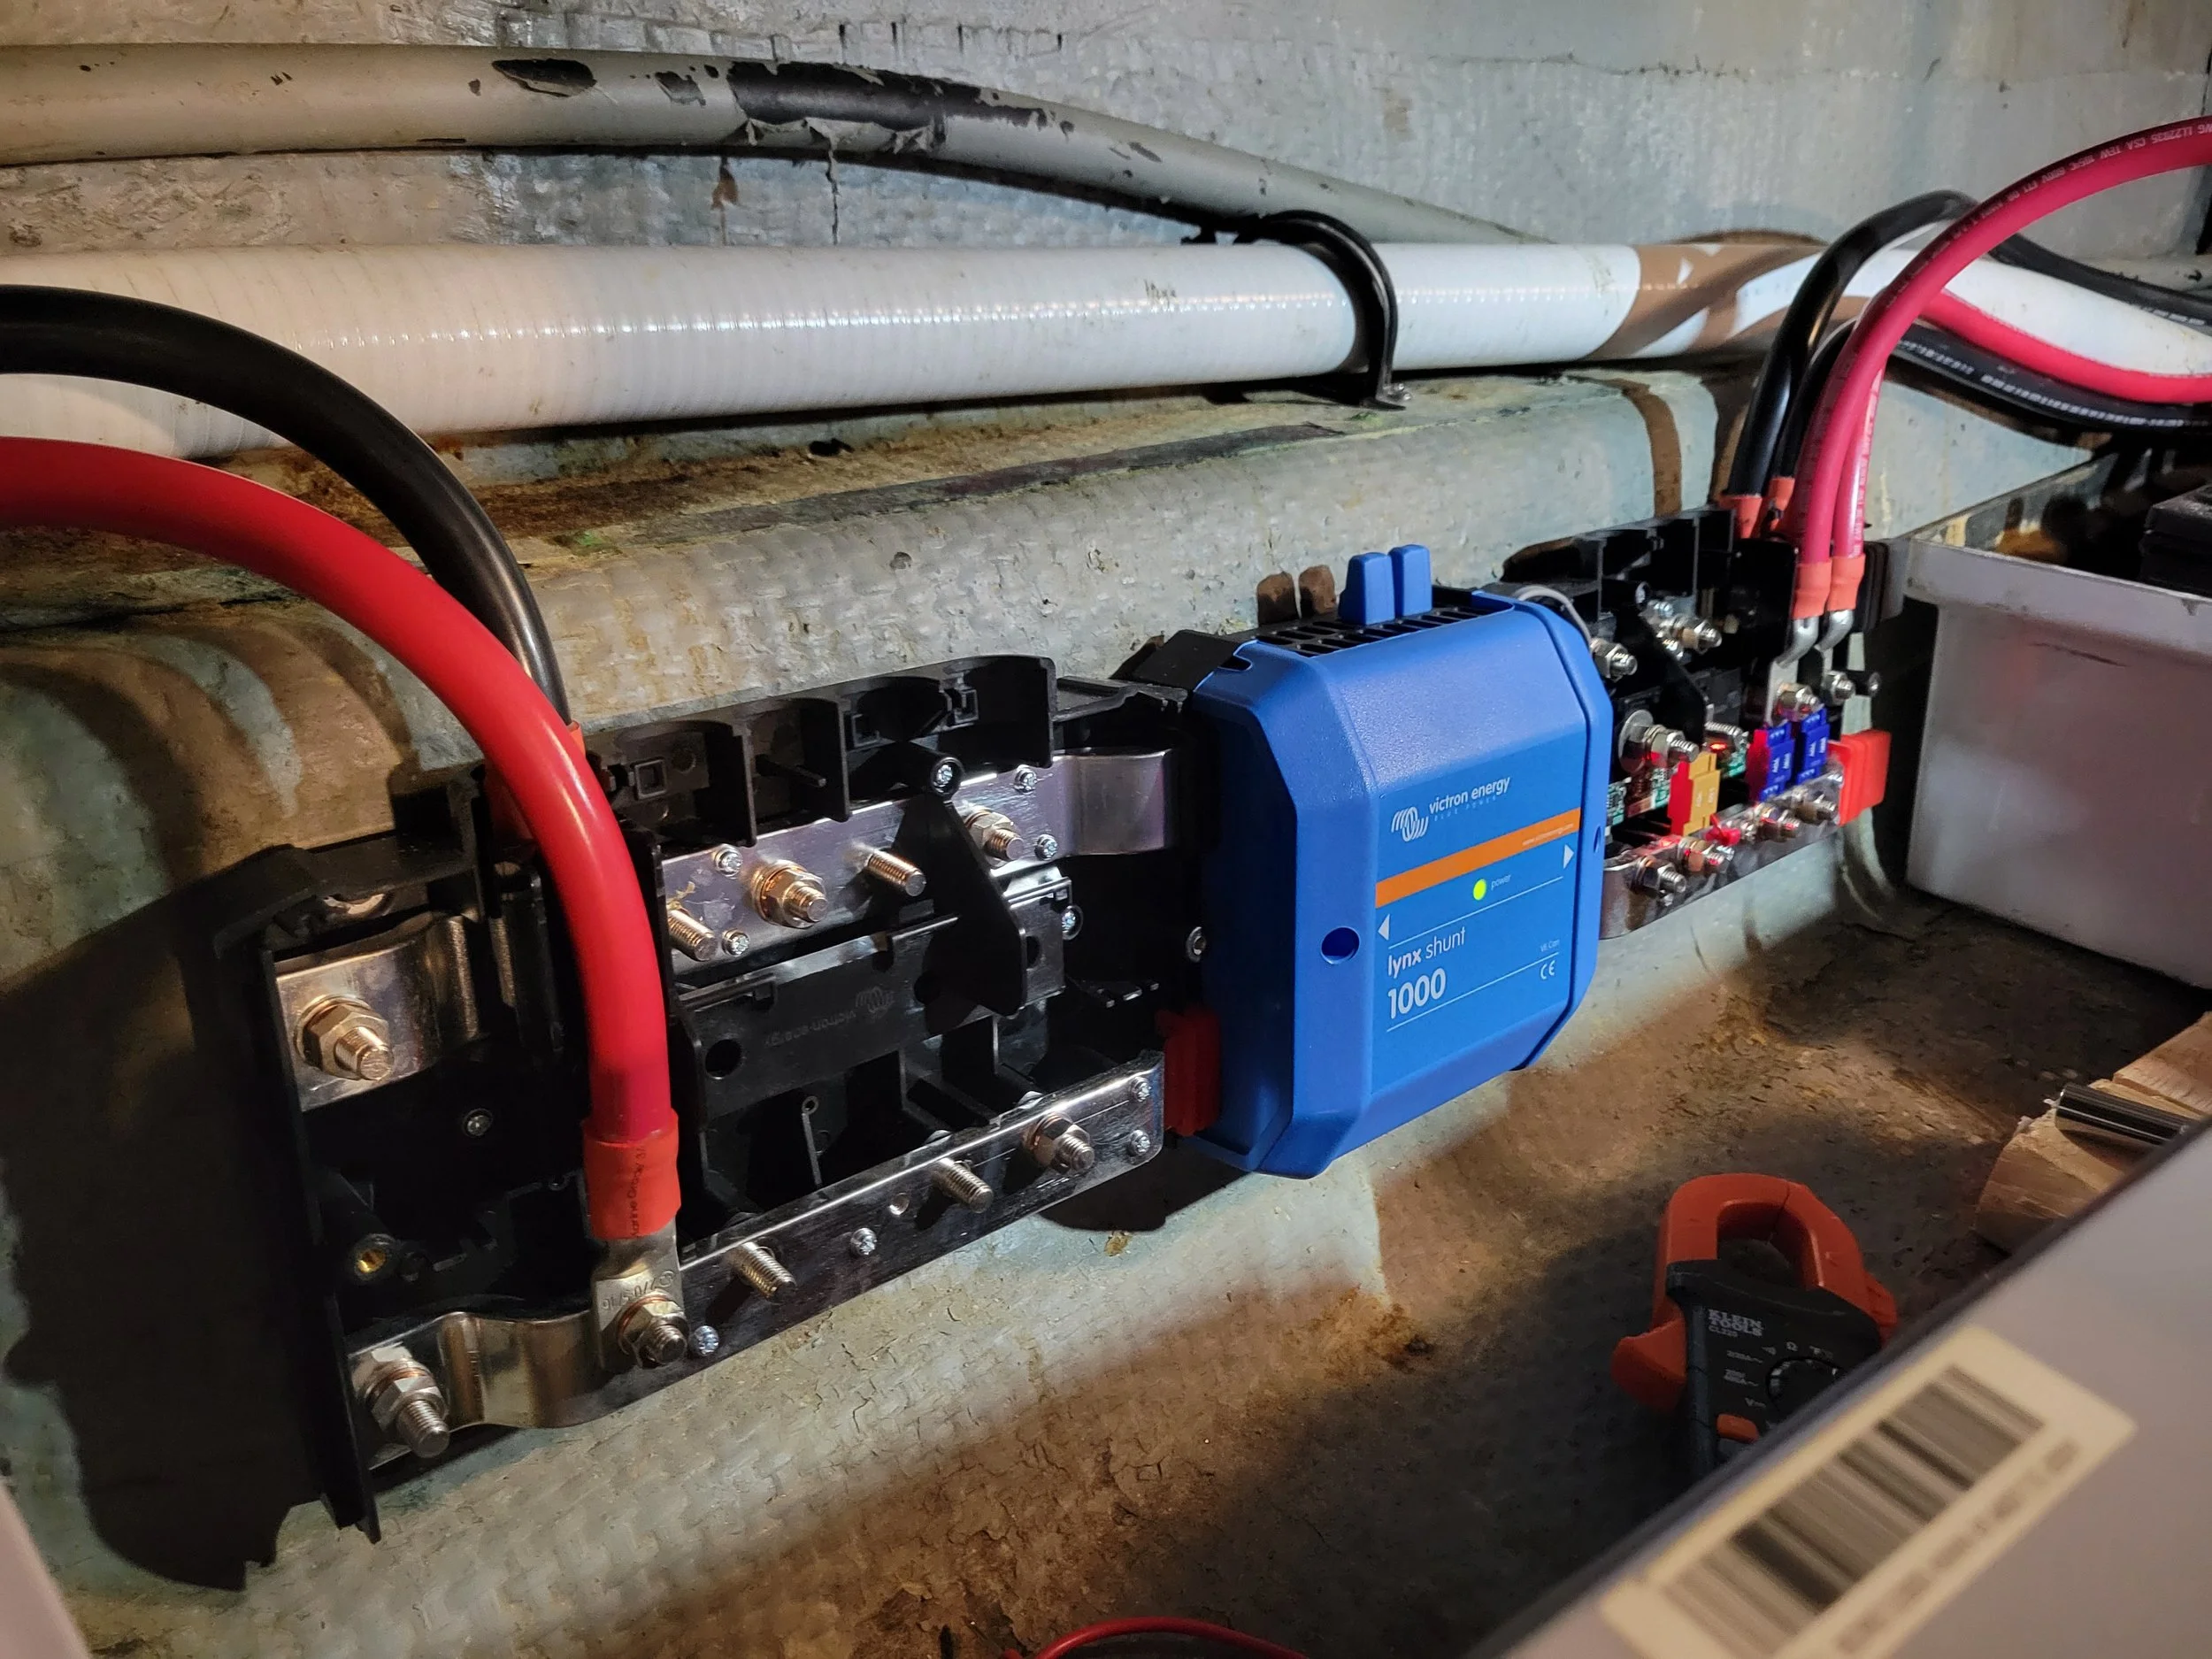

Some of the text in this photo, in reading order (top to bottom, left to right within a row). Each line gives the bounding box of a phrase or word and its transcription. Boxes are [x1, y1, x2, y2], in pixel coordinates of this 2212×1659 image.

[1429, 776, 1511, 814] victron energy
[1491, 873, 1511, 891] power
[1387, 926, 1466, 979] lynx shunt
[1387, 967, 1447, 1020] 1000
[1709, 1319, 1763, 1337] TOOLS
